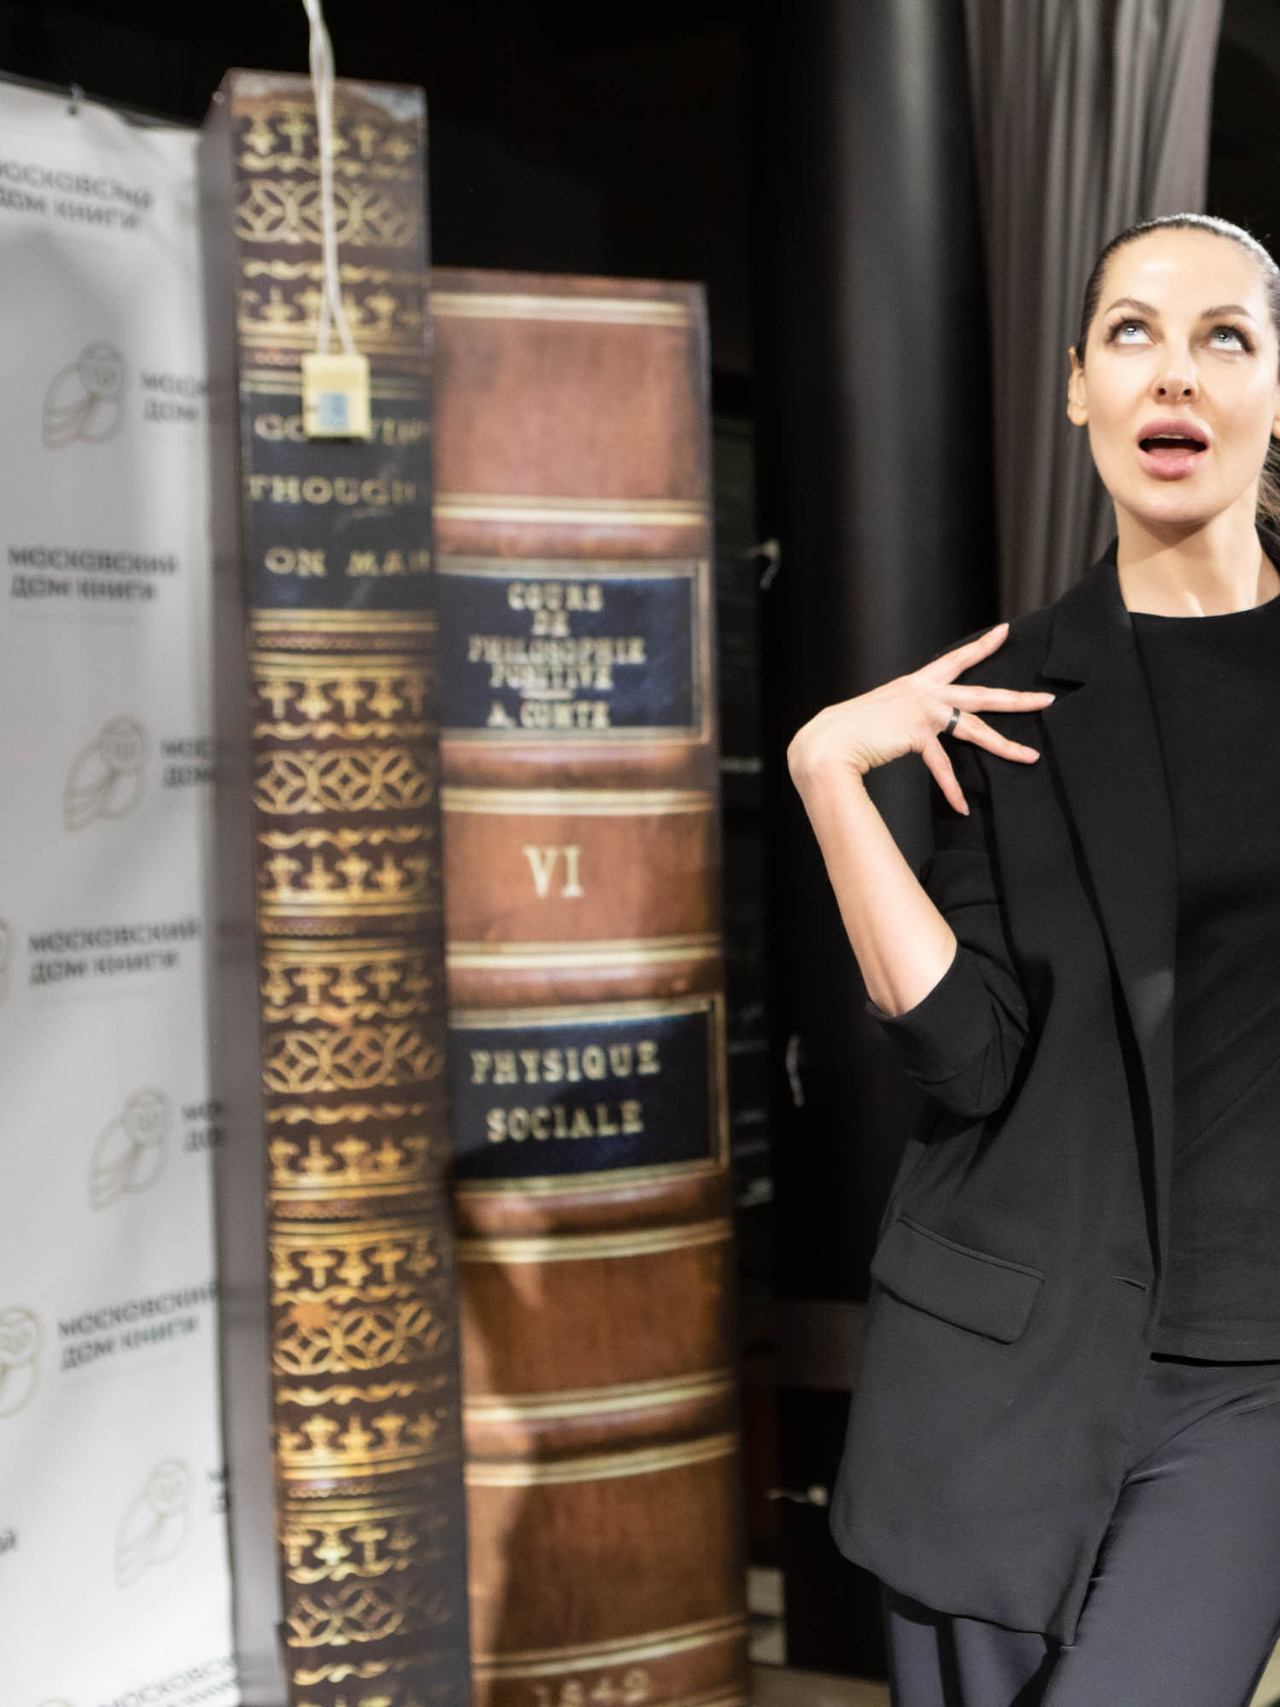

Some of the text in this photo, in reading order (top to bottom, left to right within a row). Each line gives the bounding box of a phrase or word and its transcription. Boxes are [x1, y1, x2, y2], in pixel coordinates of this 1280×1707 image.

[523, 845, 584, 898] VI
[471, 1040, 660, 1084] PHYSIQUE
[486, 1099, 644, 1143] SOCIALE
